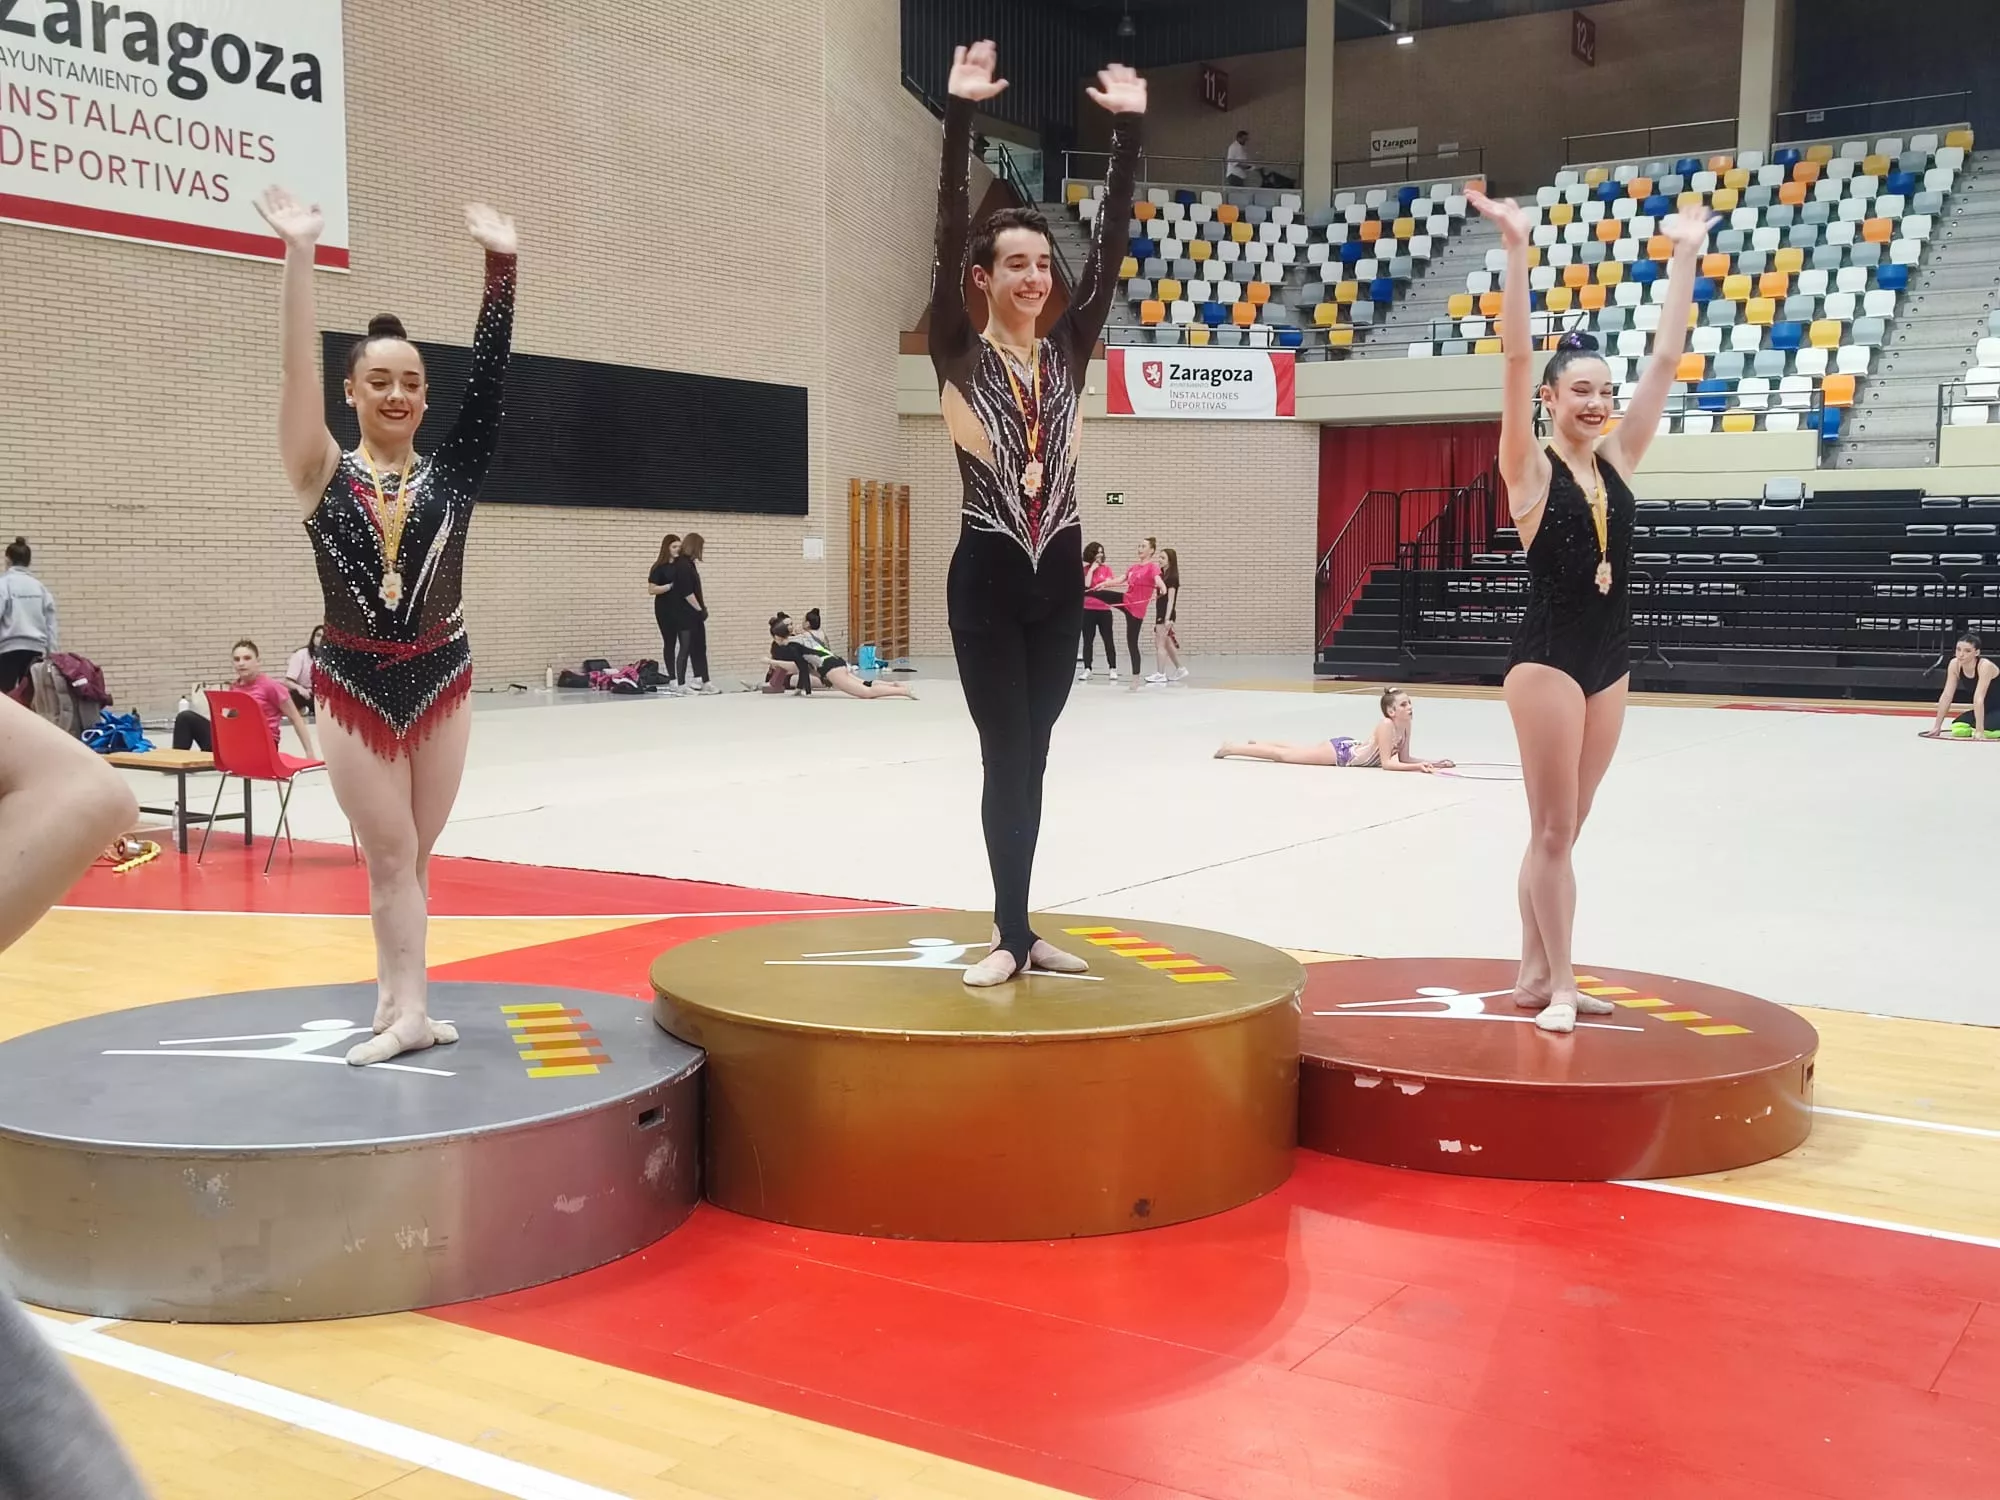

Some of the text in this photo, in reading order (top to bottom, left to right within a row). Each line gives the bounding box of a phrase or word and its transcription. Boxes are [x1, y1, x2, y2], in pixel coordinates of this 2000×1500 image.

[1576, 20, 1587, 54] 12
[0, 46, 158, 97] AYUNTAMIENTO
[1204, 70, 1216, 100] 11
[1383, 138, 1417, 149] Zaragoza
[0, 125, 230, 203] DEPORTIVAS
[1169, 364, 1253, 387] Zaragoza
[1169, 389, 1239, 400] INSTALACIONES
[1170, 399, 1227, 410] DEPORTIVAS
